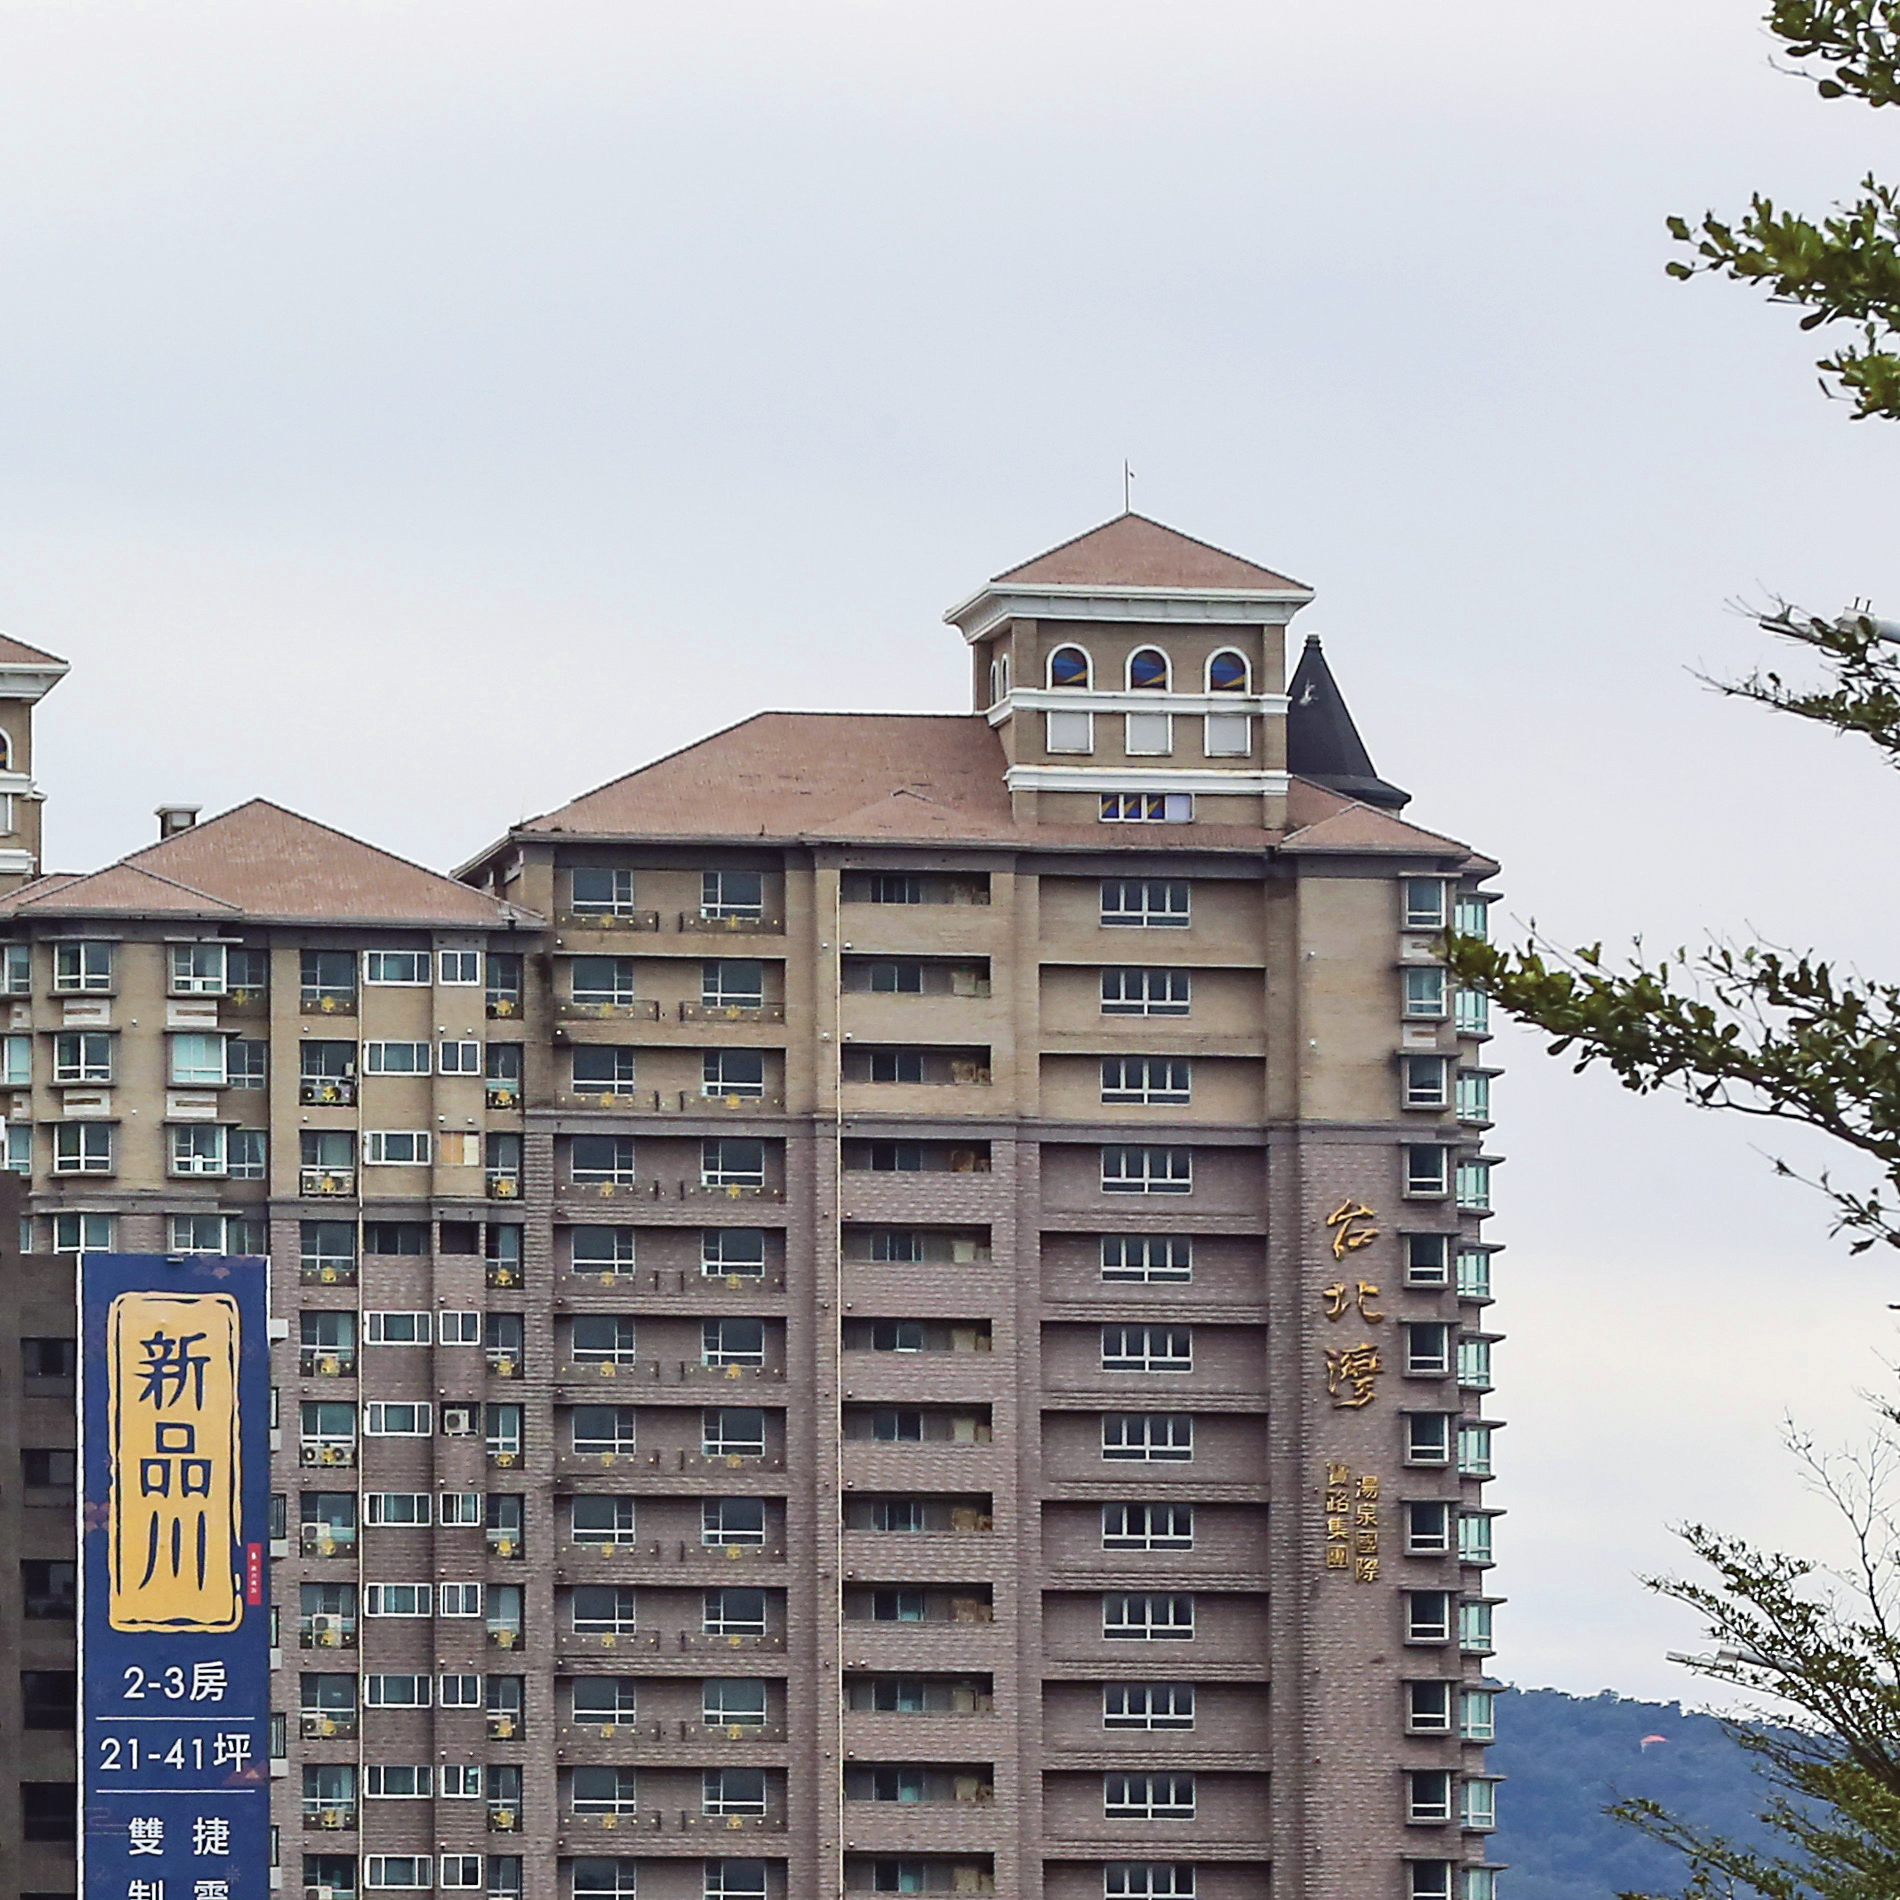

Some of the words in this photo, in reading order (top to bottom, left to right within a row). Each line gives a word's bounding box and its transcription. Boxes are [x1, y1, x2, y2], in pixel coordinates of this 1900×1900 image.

[1323, 1199, 1385, 1409] 台北灣
[132, 1330, 211, 1591] 新品川
[1355, 1475, 1379, 1583] 湯泉國際
[123, 1660, 228, 1701] 2-3房
[100, 1732, 251, 1772] 21-41坪
